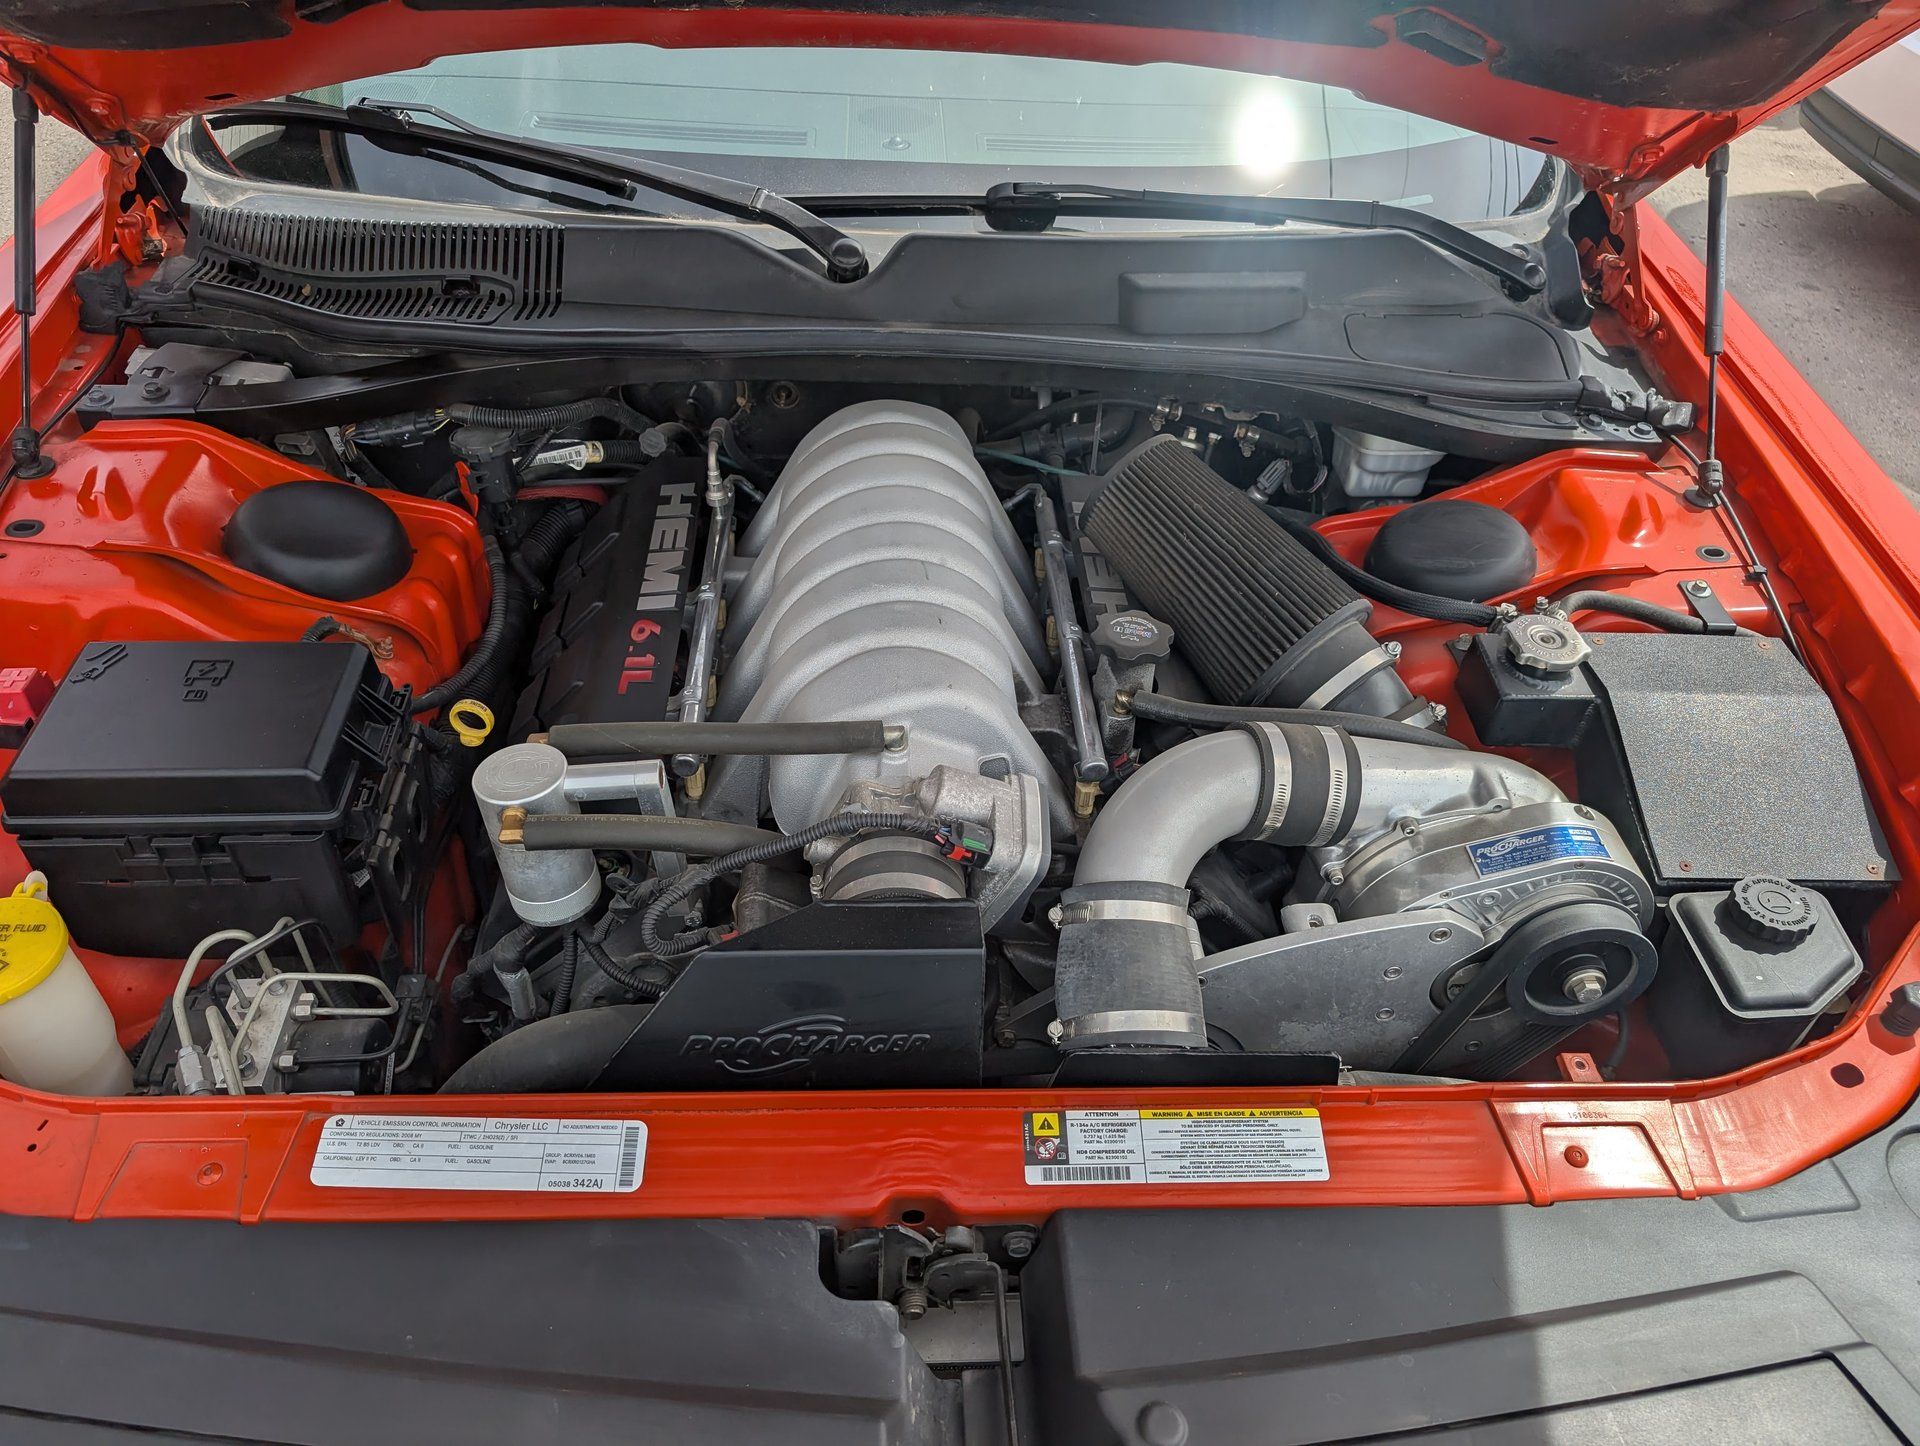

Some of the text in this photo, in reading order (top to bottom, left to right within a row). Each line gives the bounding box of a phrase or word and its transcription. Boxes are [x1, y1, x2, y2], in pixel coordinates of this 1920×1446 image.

[636, 482, 697, 611] HEMI
[617, 618, 661, 694] 6.1L
[1476, 834, 1545, 856] PROCHARGER
[1752, 878, 1797, 893] APPROVED
[1768, 914, 1808, 926] STEERING
[13, 924, 46, 932] FLUID
[680, 1034, 932, 1056] PROCHARGER
[494, 1122, 530, 1131] Chrysler
[572, 1179, 603, 1189] 342AJ
